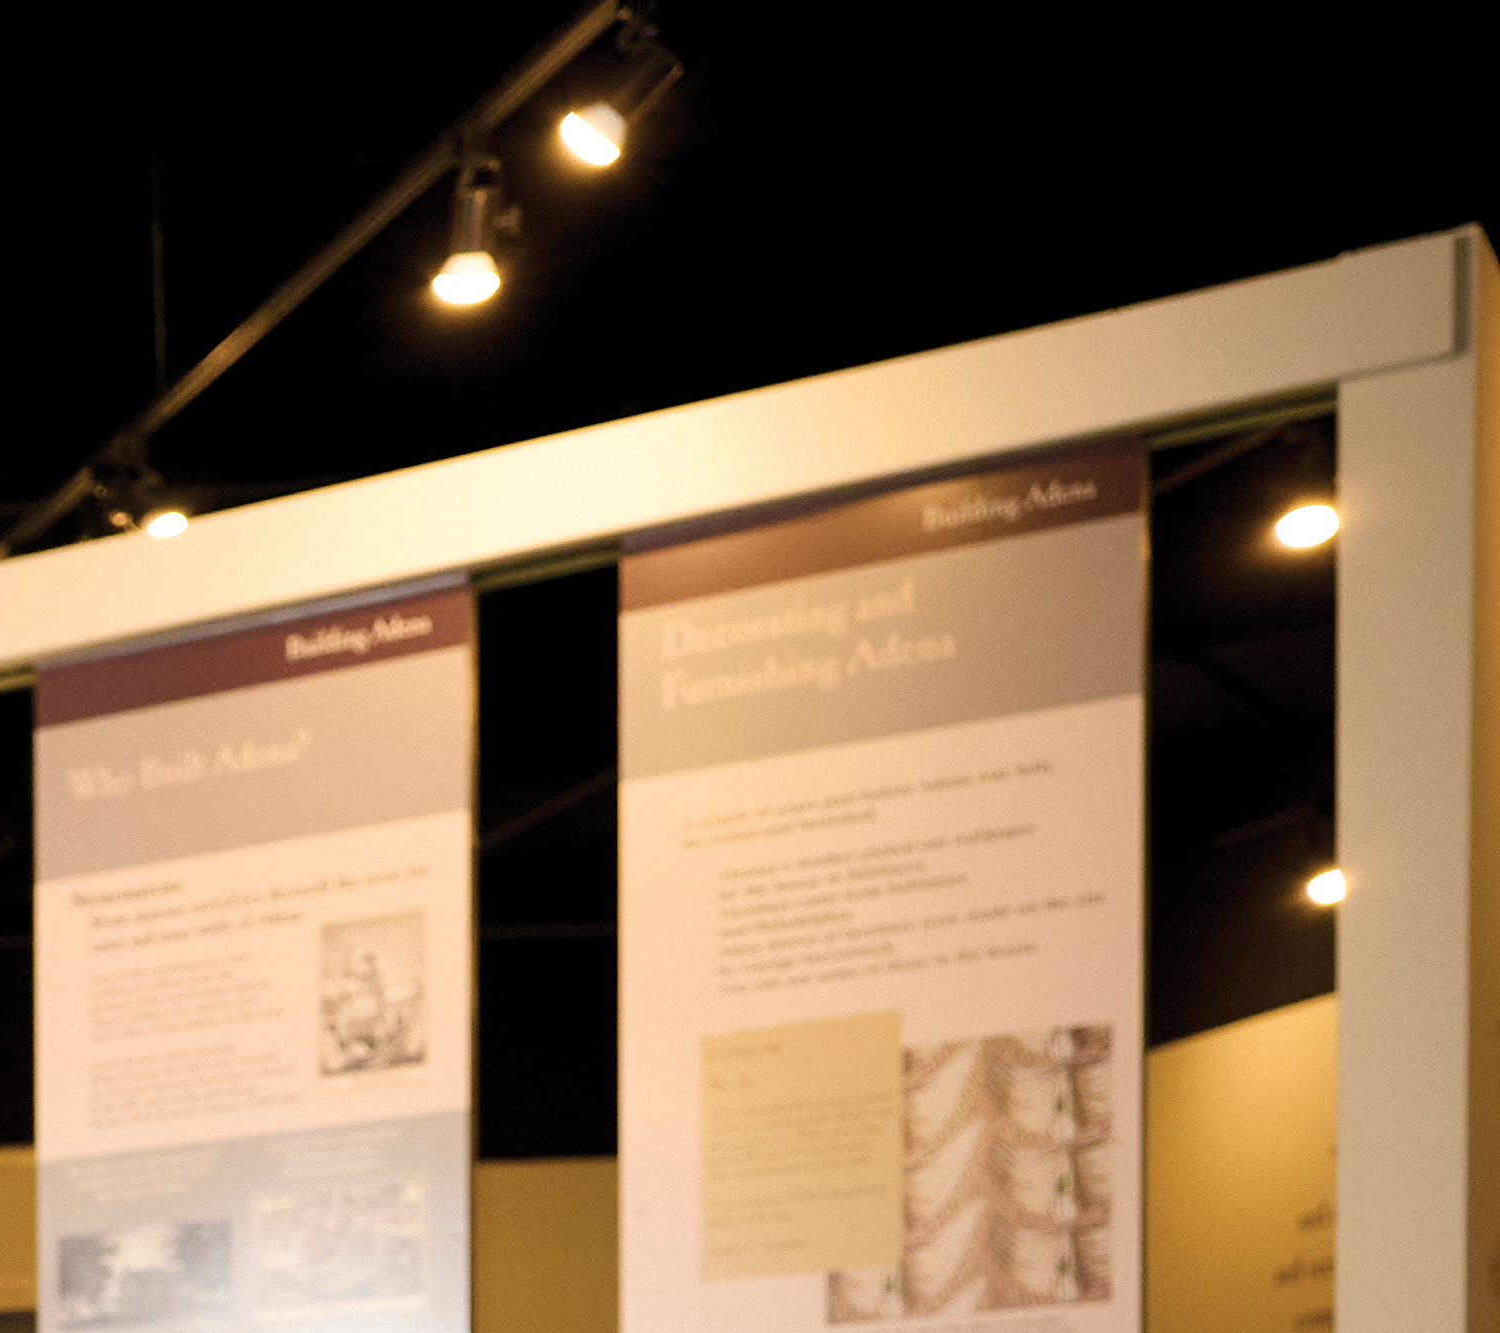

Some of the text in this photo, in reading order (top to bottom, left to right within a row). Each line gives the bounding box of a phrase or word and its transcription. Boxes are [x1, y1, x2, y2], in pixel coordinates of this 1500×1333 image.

[923, 478, 1098, 532] Building Adena
[285, 613, 432, 661] Building Adena
[662, 579, 916, 660] Decorating and
[662, 633, 957, 709] Furnishing Adena
[68, 728, 312, 800] Who Built Adena?
